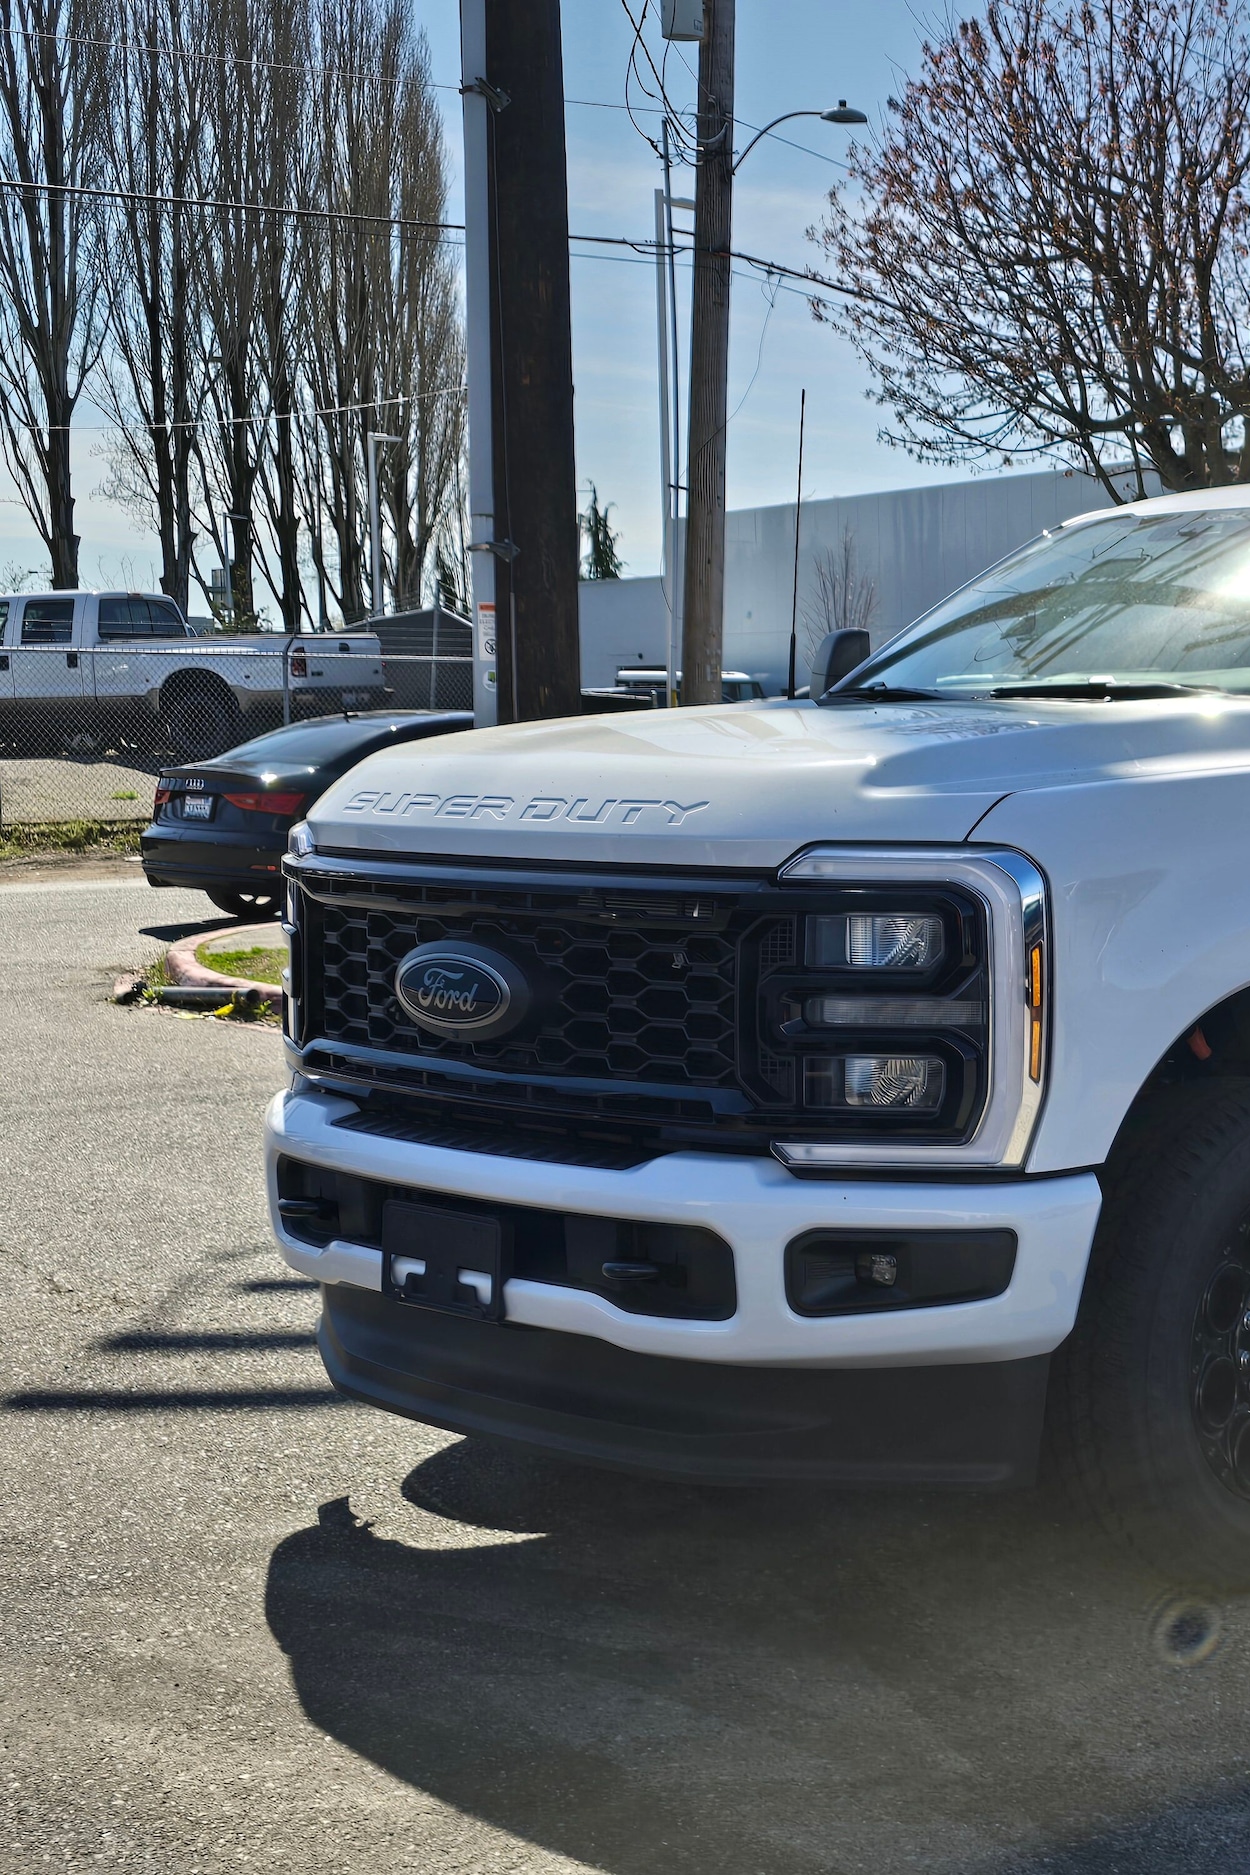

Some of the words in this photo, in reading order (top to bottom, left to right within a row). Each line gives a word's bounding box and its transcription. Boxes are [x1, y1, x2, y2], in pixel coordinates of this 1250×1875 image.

[342, 791, 515, 821] SUPER
[518, 797, 711, 826] DUTY
[417, 967, 479, 1013] Ford
